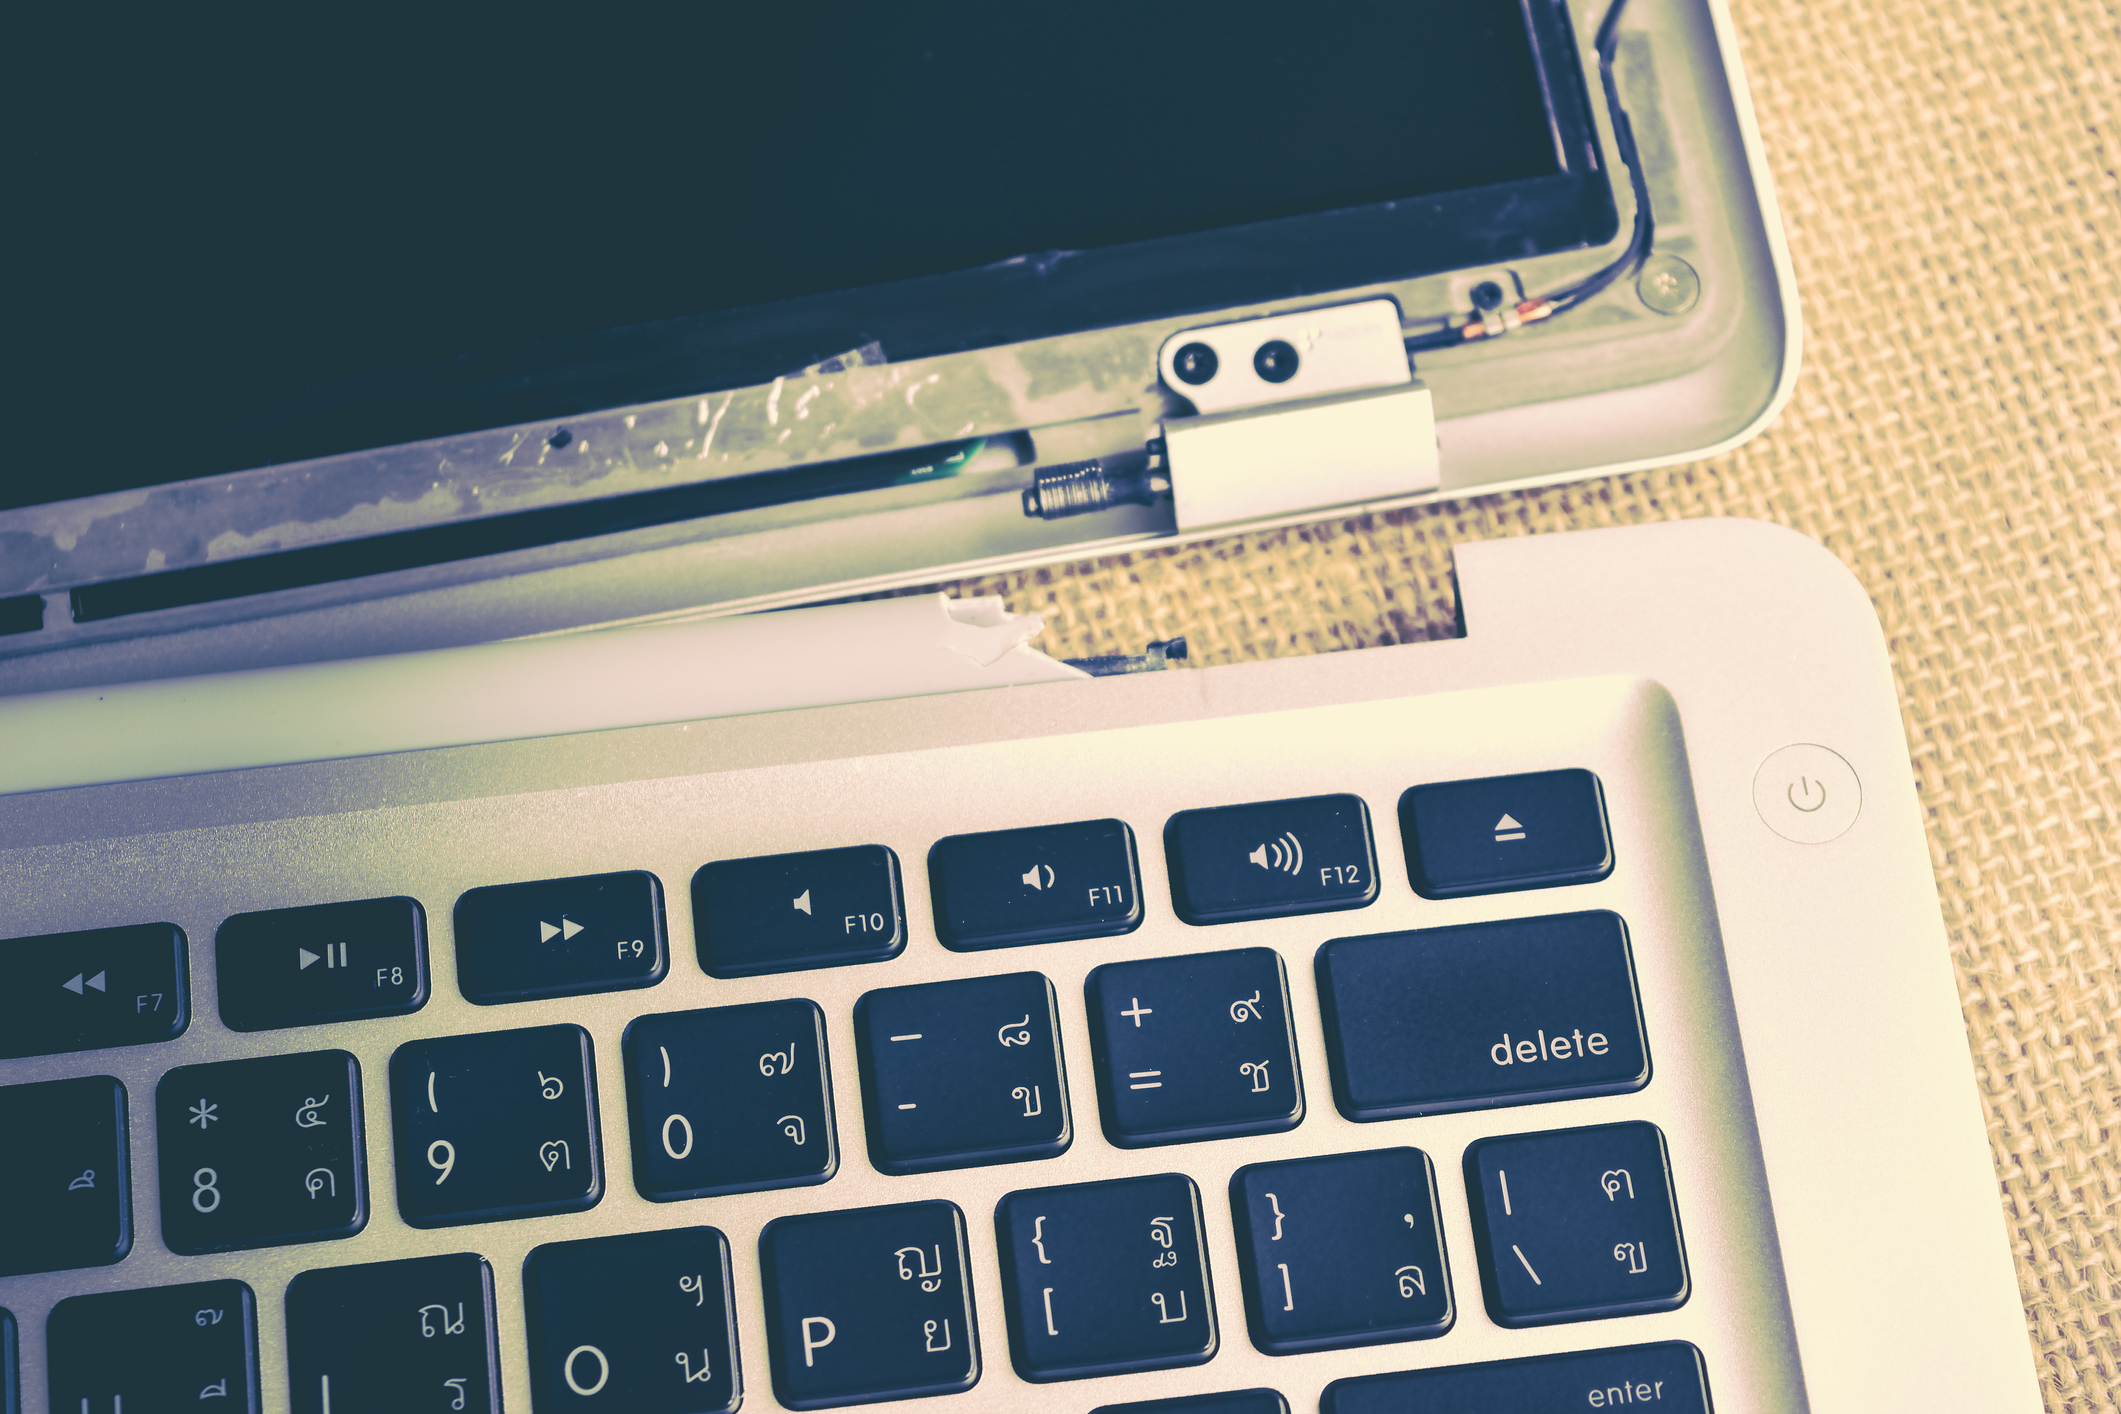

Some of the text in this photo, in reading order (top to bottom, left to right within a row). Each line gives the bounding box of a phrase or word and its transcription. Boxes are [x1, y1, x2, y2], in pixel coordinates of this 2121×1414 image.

[1321, 865, 1359, 886] F12
[1089, 886, 1122, 906] F11
[845, 913, 883, 934] F10
[618, 940, 643, 959] F9
[377, 967, 403, 986] F8
[137, 994, 162, 1013] F7
[1121, 998, 1152, 1027] +
[1230, 990, 1262, 1022] ๙
[999, 1014, 1030, 1047] ๘
[760, 1043, 795, 1076] ๗
[1491, 1029, 1608, 1065] delete
[660, 1047, 670, 1087] )
[1129, 1071, 1162, 1089] =
[1240, 1060, 1269, 1092] ช
[428, 1072, 437, 1112] (
[538, 1071, 563, 1099] ๖
[1012, 1086, 1041, 1116] ข
[296, 1095, 329, 1127] ๕
[777, 1115, 805, 1145] จ
[428, 1140, 455, 1185] 9
[193, 1168, 220, 1212] 8
[306, 1168, 335, 1199] ค
[1266, 1193, 1285, 1240] }
[1032, 1216, 1051, 1264] {
[1151, 1217, 1177, 1268] ฐ
[894, 1245, 941, 1292] ญ
[1513, 1245, 1541, 1285] \
[1278, 1264, 1293, 1311] ]
[1395, 1266, 1425, 1298] ล
[419, 1303, 464, 1337] ณ
[1043, 1288, 1058, 1335] [
[1151, 1291, 1187, 1323] บ
[802, 1317, 835, 1367] P
[924, 1319, 950, 1352] ย
[565, 1345, 609, 1395] O
[676, 1349, 711, 1383] น
[444, 1379, 466, 1410] ร
[1589, 1381, 1663, 1407] enter
